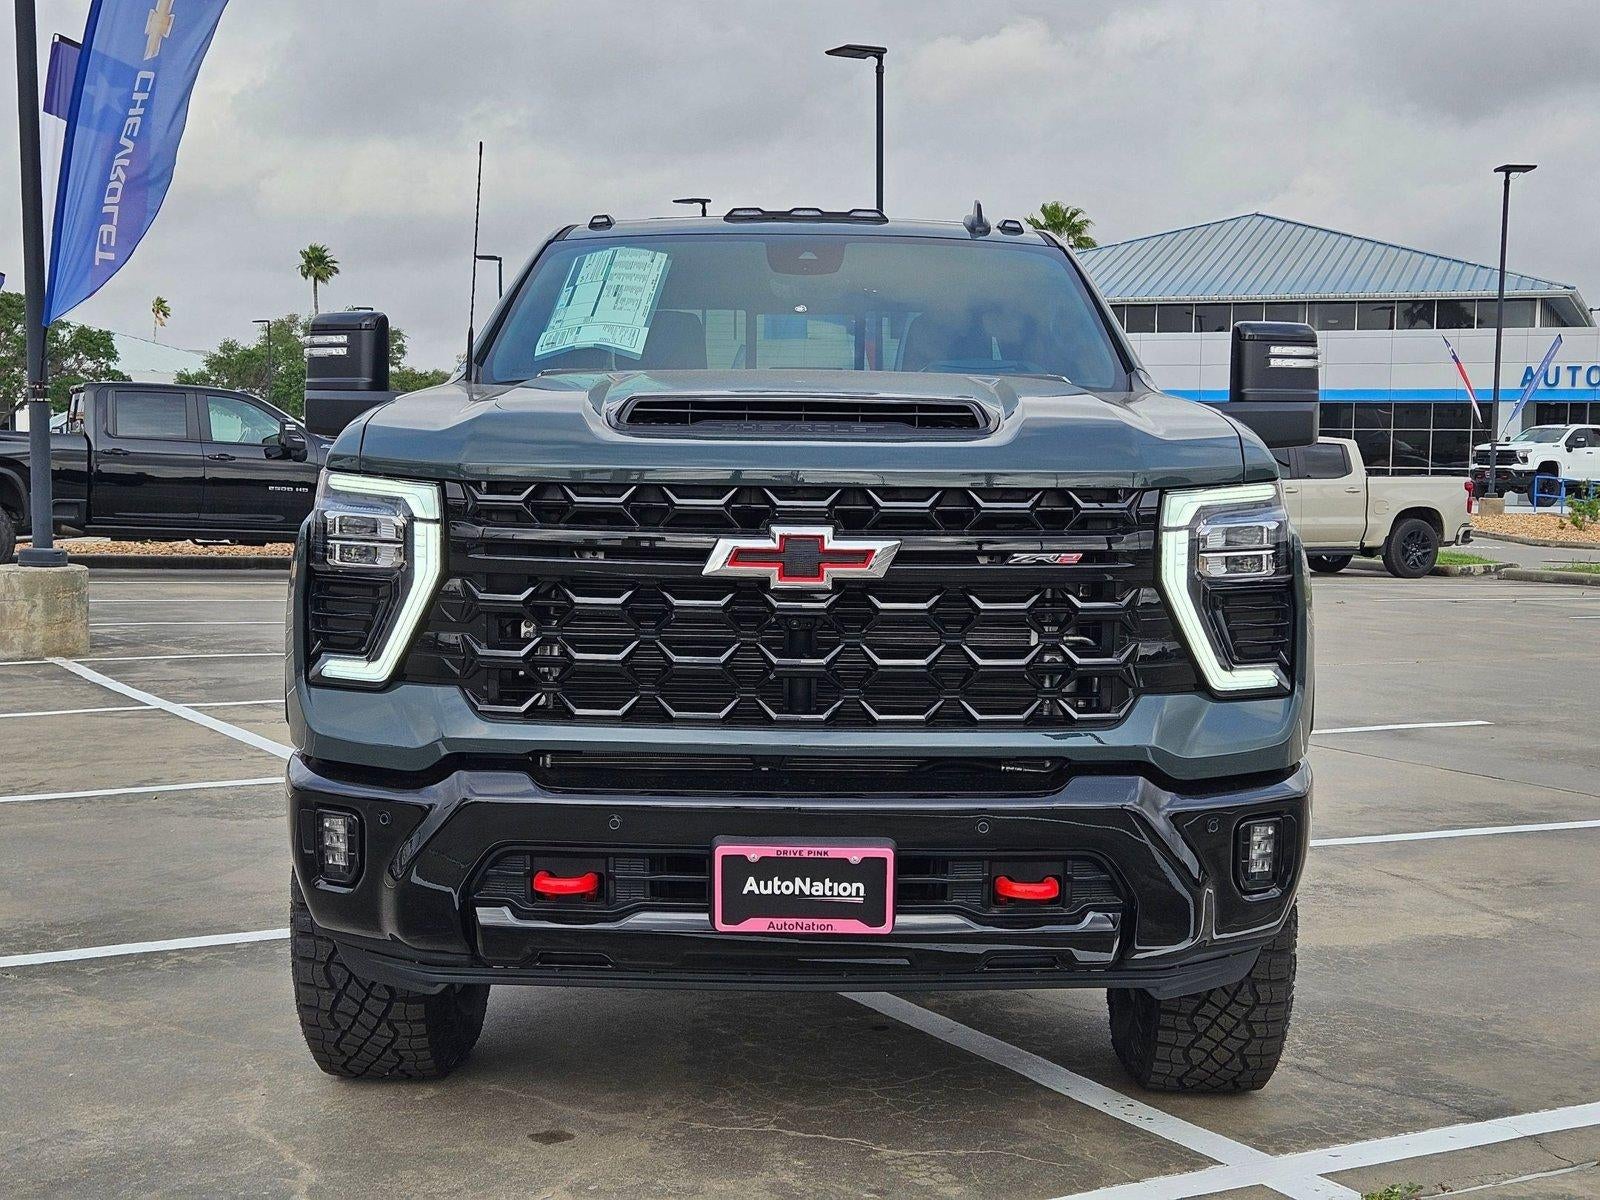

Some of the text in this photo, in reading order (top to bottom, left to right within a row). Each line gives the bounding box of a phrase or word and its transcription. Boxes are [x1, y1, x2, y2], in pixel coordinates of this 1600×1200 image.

[721, 423, 885, 433] CHEVROLET
[1008, 552, 1084, 564] ZR2
[776, 849, 804, 857] DRIVE
[742, 876, 865, 897] AutoNation
[767, 921, 834, 932] AutoNation
